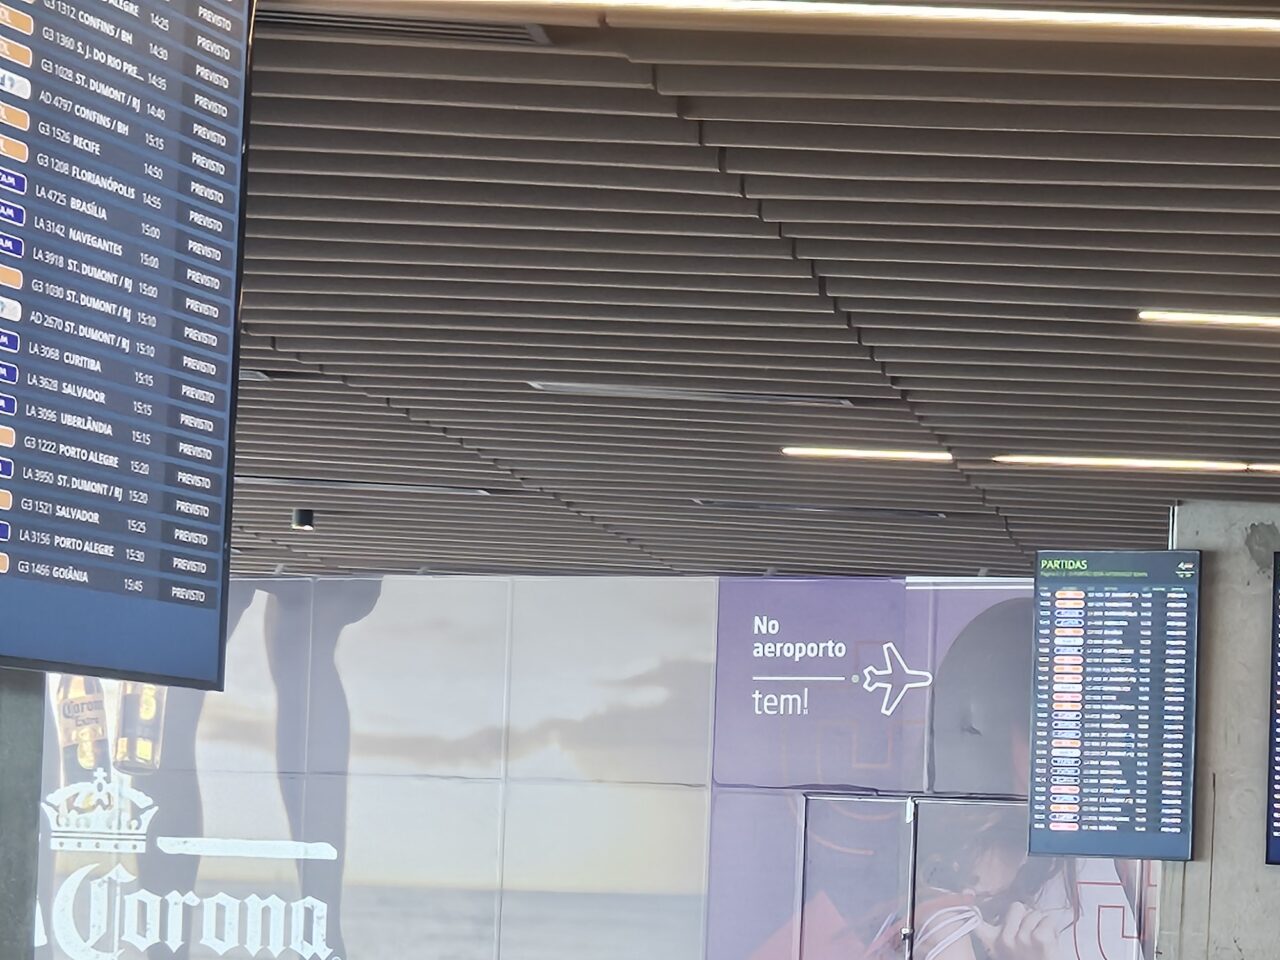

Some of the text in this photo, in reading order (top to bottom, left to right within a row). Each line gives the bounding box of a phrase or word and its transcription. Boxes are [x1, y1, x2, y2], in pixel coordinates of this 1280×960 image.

[57, 1, 76, 19] 1312
[78, 11, 114, 35] CONFINS
[121, 30, 132, 44] BH
[149, 43, 168, 60] 14:30
[196, 64, 228, 88] PREVISTO
[150, 13, 230, 59] 14:25 PREVISTO
[198, 6, 231, 30] PREVISTO
[42, 26, 54, 41] G3
[93, 48, 106, 63] DO
[107, 54, 121, 70] RIO
[148, 73, 166, 90] 14:35
[194, 94, 227, 116] PREVISTO
[41, 58, 52, 73] G3
[75, 73, 88, 88] ST.
[89, 79, 125, 102] DUMONT
[132, 97, 140, 112] RJ
[147, 103, 165, 120] 14:40
[193, 123, 226, 146] PREVISTO
[39, 90, 54, 104] AD
[74, 105, 110, 128] CONFINS
[117, 121, 128, 135] BH
[145, 133, 164, 150] 15:15
[192, 152, 225, 174] PREVISTO
[38, 121, 49, 135] G3
[73, 135, 100, 155] RECIFE
[144, 163, 163, 179] 14:50
[191, 182, 223, 203] PREVISTO
[36, 153, 48, 167] G3
[72, 166, 135, 198] FLORIANÓPOLIS
[142, 193, 161, 209] 14:55
[189, 211, 222, 231] PREVISTO
[35, 184, 221, 260] LA 4725 BRASÍLIA 15:00 PREVISTO
[34, 216, 220, 289] LA 3142 NAVEGANTES 15:00 PREVISTO
[33, 247, 43, 260] LA
[44, 251, 63, 267] 3918
[67, 259, 80, 273] ST.
[81, 263, 118, 284] DUMONT
[124, 277, 132, 292] RJ
[139, 282, 158, 297] 15:00
[186, 298, 218, 317] PREVISTO
[31, 279, 43, 292] G3
[66, 290, 79, 303] ST.
[80, 294, 117, 314] DUMONT
[122, 307, 131, 322] RJ
[137, 312, 156, 327] 15:10
[184, 327, 217, 346] PREVISTO
[30, 311, 42, 324] AD
[64, 321, 77, 334] ST.
[78, 325, 115, 344] DUMONT
[121, 337, 129, 352] RJ
[136, 342, 155, 357] 15:10
[183, 356, 216, 374] PREVISTO
[28, 342, 39, 354] LA
[63, 352, 101, 371] CURITIBA
[135, 371, 153, 386] 15:15
[181, 385, 214, 403] PREVISTO
[27, 373, 37, 385] LA
[62, 382, 105, 403] SALVADOR
[133, 401, 152, 415] 15:15
[180, 414, 213, 431] PREVISTO
[25, 404, 36, 417] LA
[132, 430, 150, 445] 15:15
[179, 442, 212, 459] PREVISTO
[24, 436, 36, 448] G3
[59, 444, 87, 460] PORTO
[88, 451, 118, 467] ALEGRE
[130, 461, 149, 474] 15:20
[177, 472, 210, 488] PREVISTO
[22, 467, 33, 479] LA
[57, 474, 69, 487] ST.
[71, 477, 108, 494] DUMONT
[114, 486, 122, 501] RJ
[129, 490, 148, 503] 15:20
[176, 500, 209, 516] PREVISTO
[21, 498, 32, 510] G3
[56, 505, 99, 523] SALVADOR
[127, 519, 146, 533] 15:25
[174, 529, 207, 544] PREVISTO
[19, 529, 206, 573] LA 3156 PORTO ALEGRE 15:30 PREVISTO
[1041, 560, 1088, 570] PARTIDAS
[17, 560, 29, 573] G3
[124, 579, 143, 591] 15:45
[171, 587, 205, 601] PREVISTO
[752, 640, 847, 662] aeroporto
[753, 615, 780, 635] No
[752, 687, 809, 715] tem!
